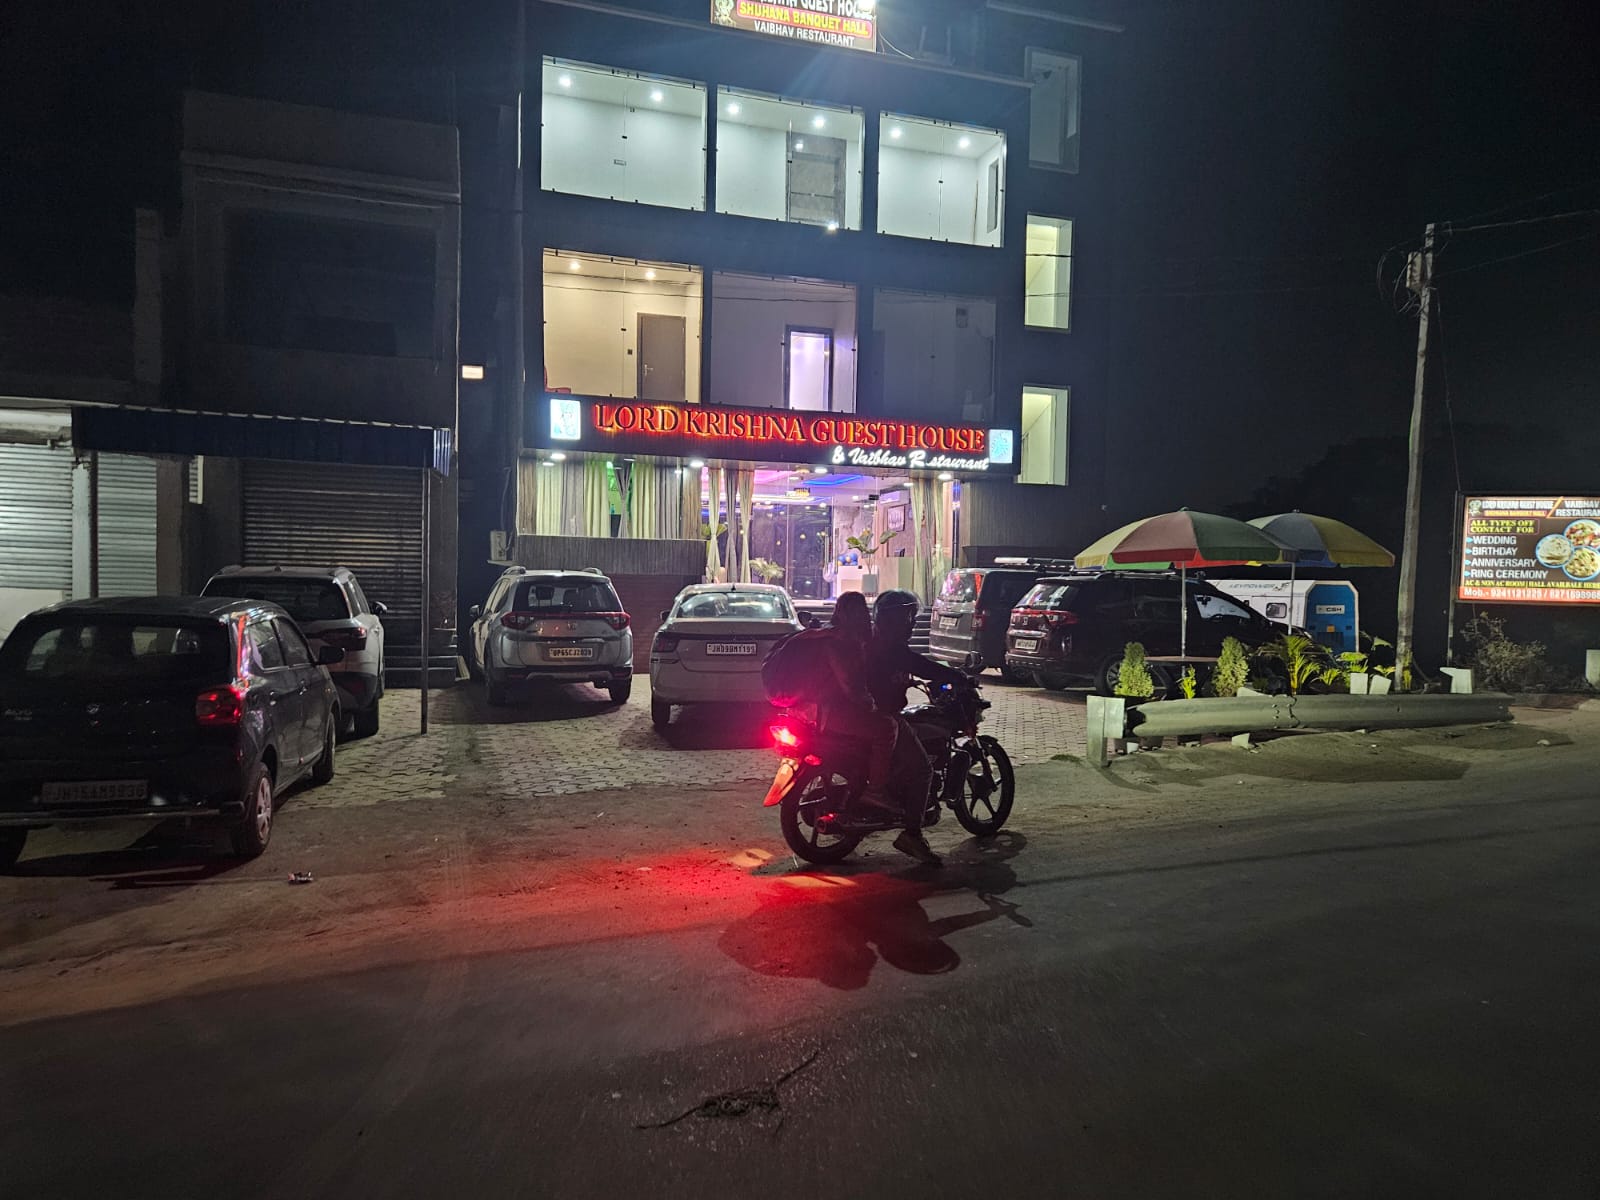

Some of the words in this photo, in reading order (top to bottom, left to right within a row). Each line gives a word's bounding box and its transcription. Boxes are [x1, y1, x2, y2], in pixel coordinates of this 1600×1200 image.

[739, 3, 790, 22] SHUHANA
[793, 10, 839, 30] BANQUET
[843, 19, 869, 35] HALL
[754, 20, 795, 38] VAIBHAV
[797, 27, 855, 48] RESTAURANT
[595, 404, 680, 432] LORD
[684, 409, 808, 442] KRISHNA
[810, 419, 897, 447] GUEST
[900, 425, 985, 451] HOUSE
[832, 445, 845, 465] &
[849, 447, 906, 466] Vaibhav
[1473, 536, 1517, 545] WEDDING
[1471, 547, 1518, 556] BIRTHDAY
[1471, 558, 1537, 568] ANNIVERSARY
[1471, 569, 1494, 578] RING
[1496, 570, 1549, 579] CEREMONY
